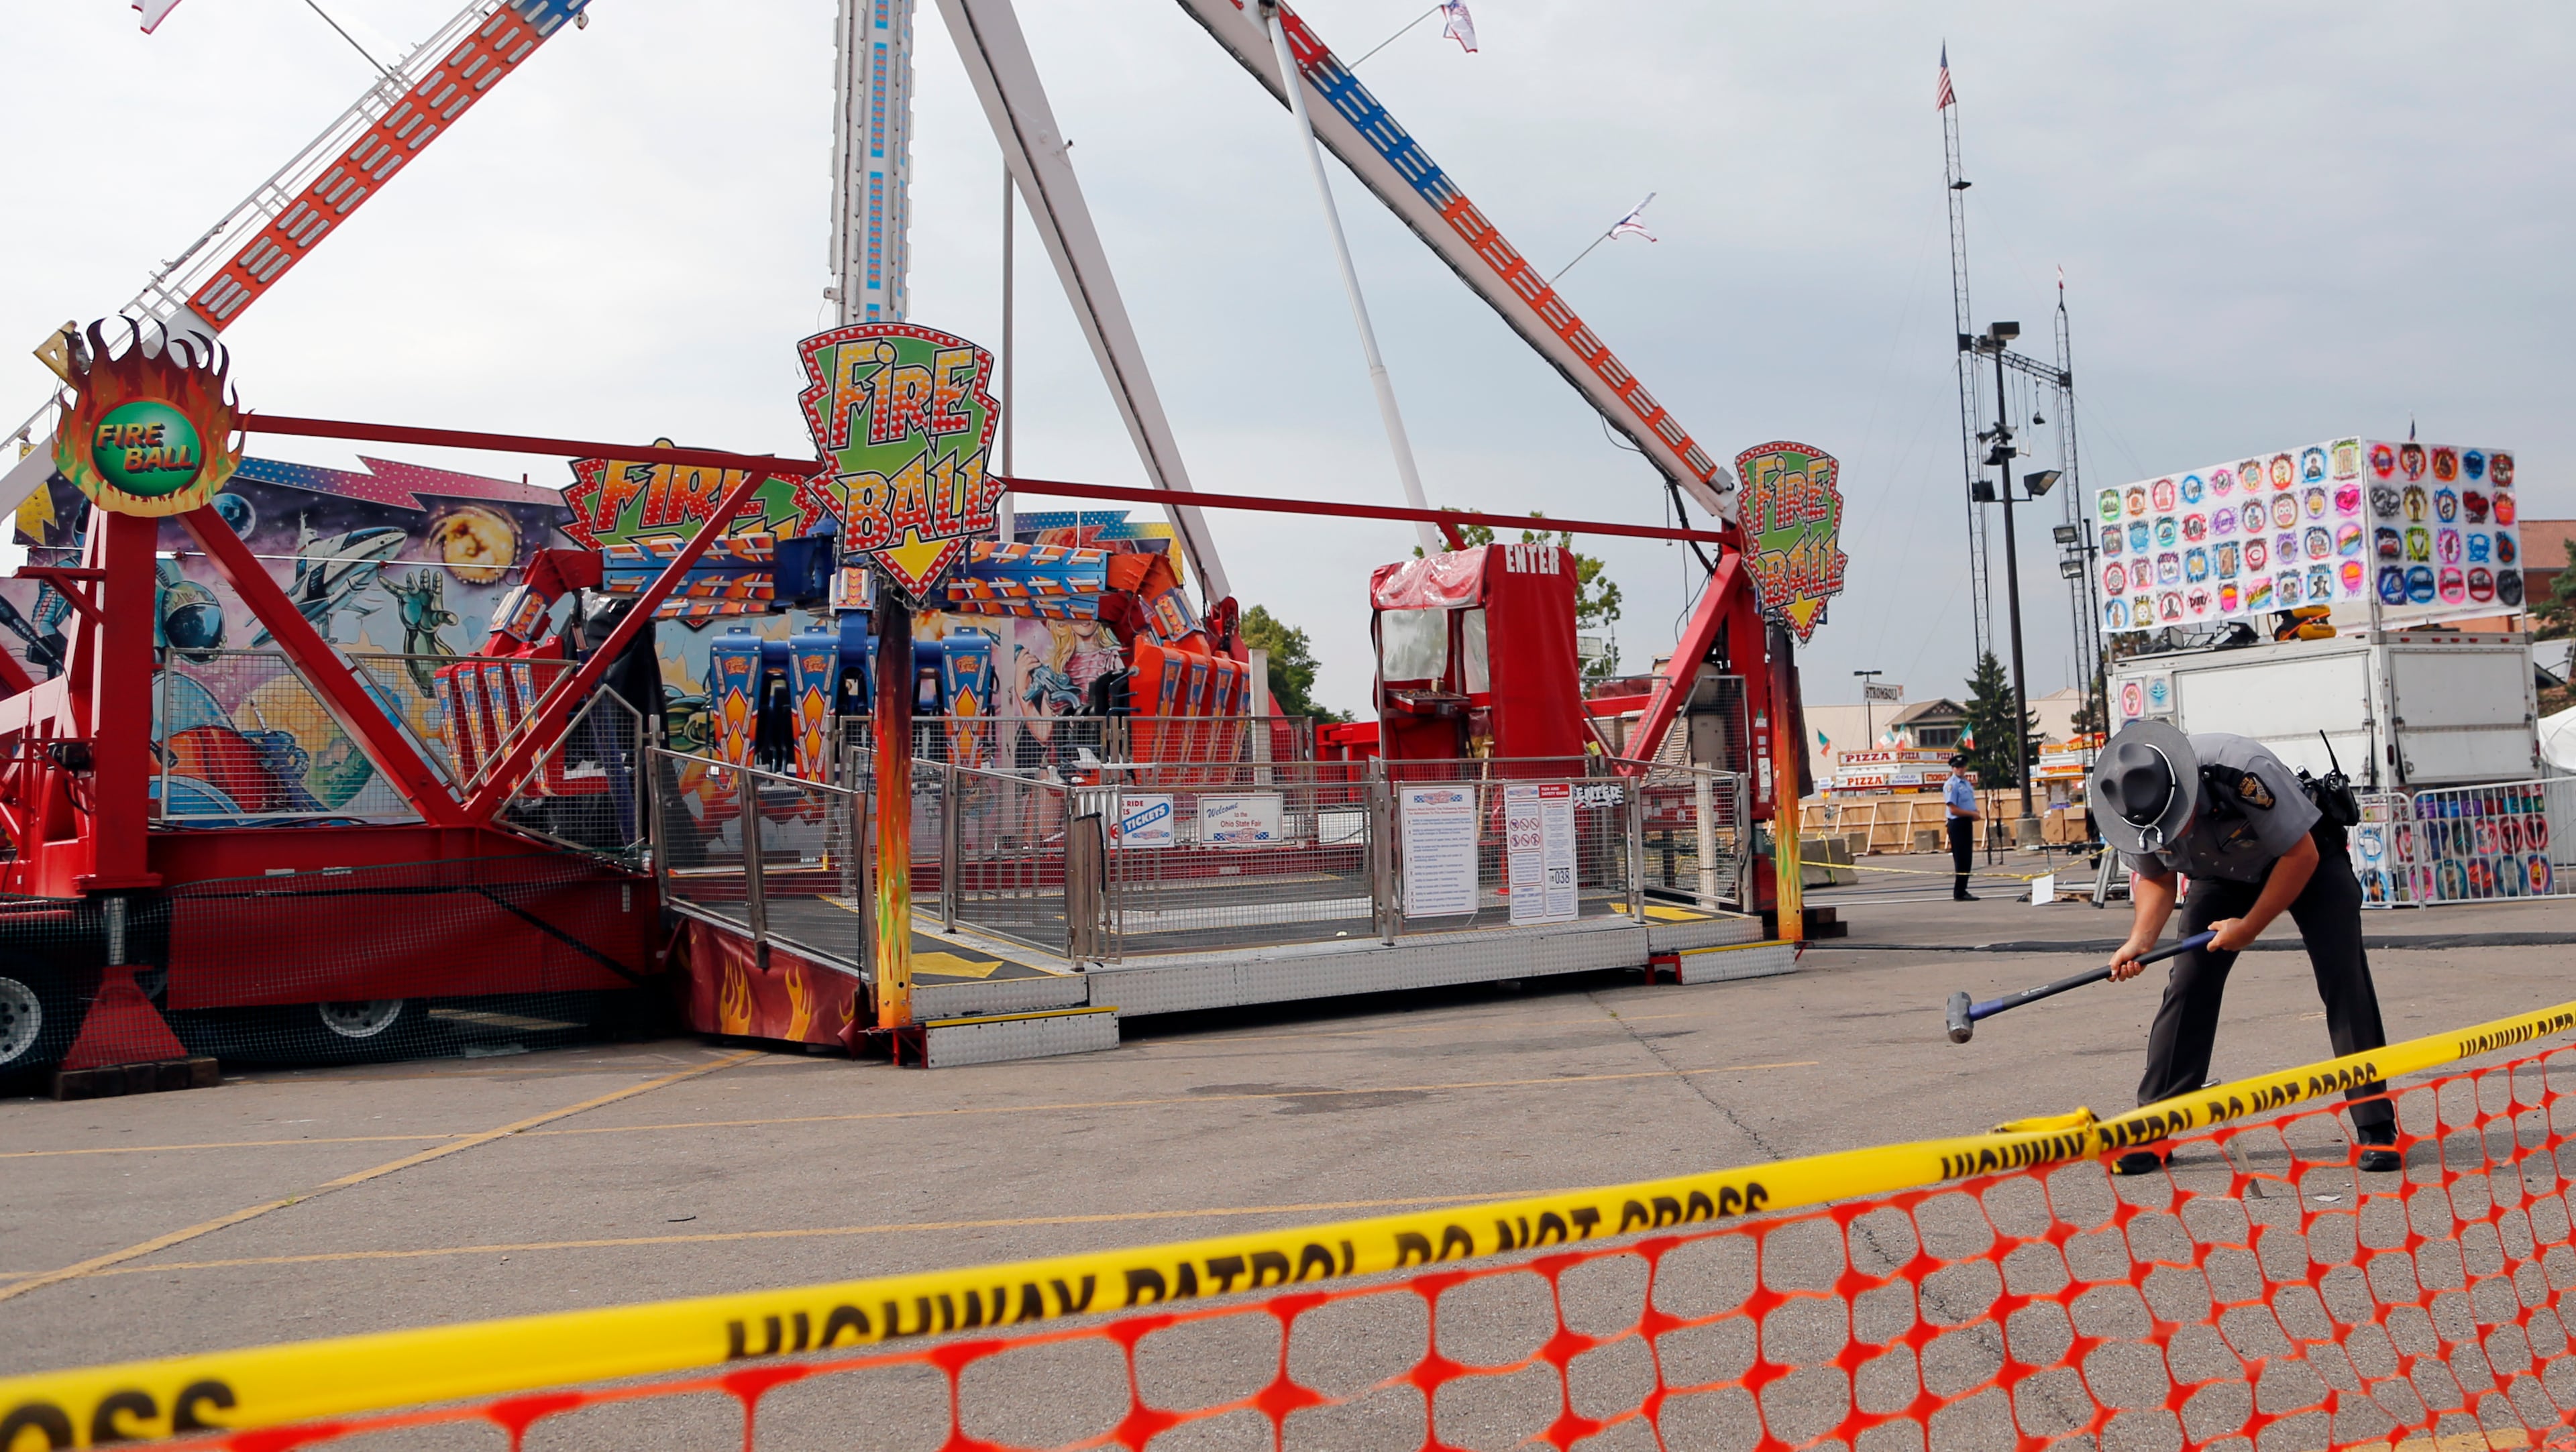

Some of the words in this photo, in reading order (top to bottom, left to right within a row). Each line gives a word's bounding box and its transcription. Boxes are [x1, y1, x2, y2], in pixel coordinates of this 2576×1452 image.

[97, 422, 165, 450] FIRE
[123, 445, 197, 473] BALL
[833, 447, 998, 554] BALL
[1505, 545, 1560, 575] ENTER
[1758, 530, 1844, 611] BALL
[1866, 686, 1897, 700] STROMBOLI
[1845, 752, 1890, 763] PIZZA
[1900, 752, 1920, 760] PIZZA
[1847, 776, 1882, 786] PIZZA
[1126, 805, 1166, 831] TICKETS
[1206, 802, 1239, 818] Welcome
[1555, 871, 1570, 884] 038
[2537, 1011, 2576, 1037] PATR
